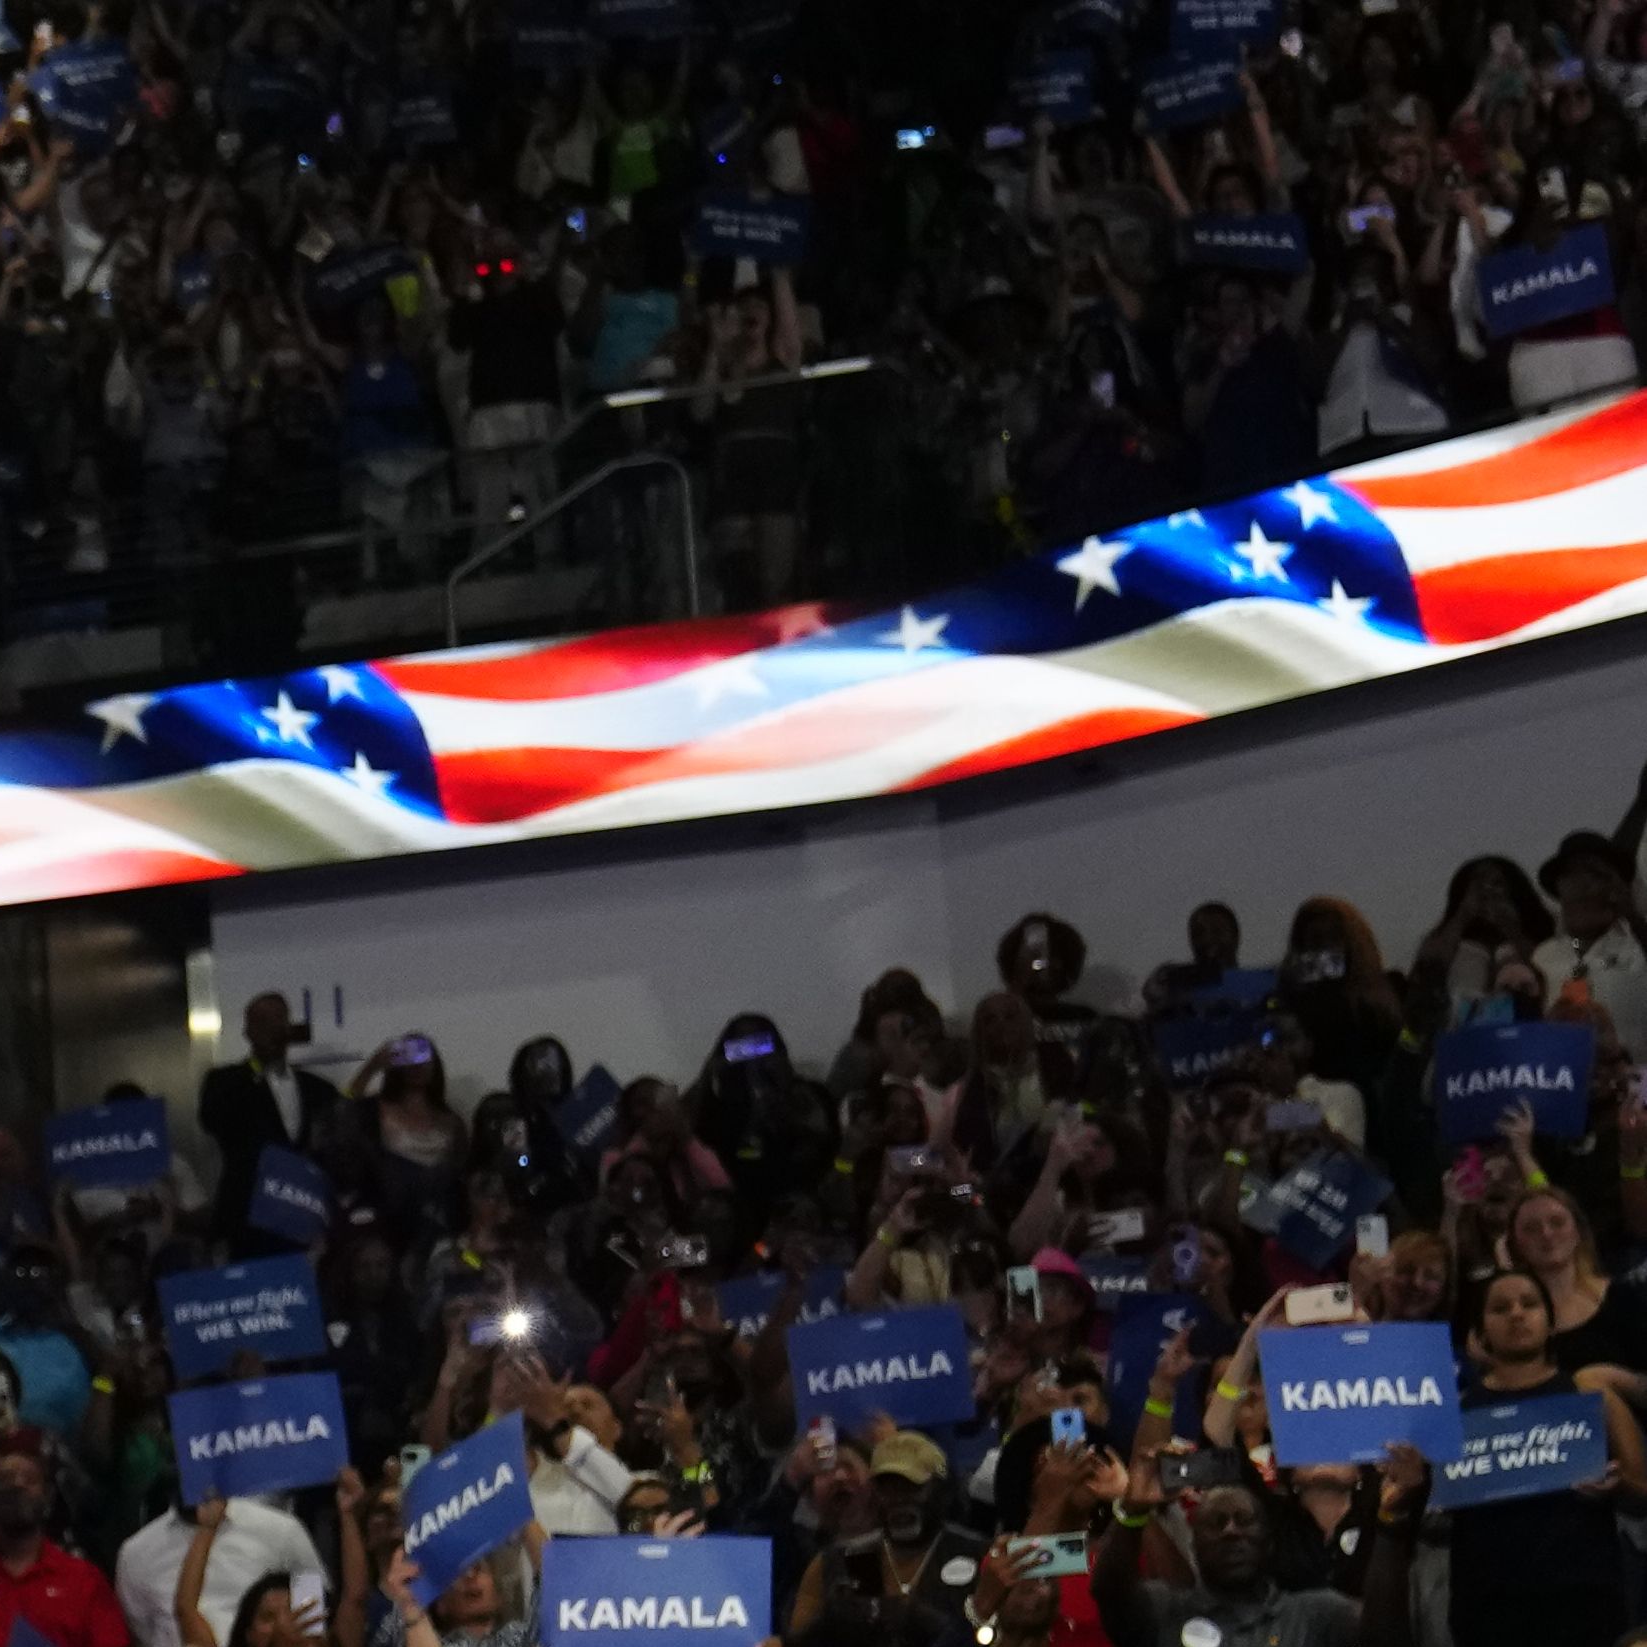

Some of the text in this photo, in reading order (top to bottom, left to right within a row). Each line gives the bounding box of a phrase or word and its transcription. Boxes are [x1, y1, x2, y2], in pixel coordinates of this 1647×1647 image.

[1492, 257, 1599, 305] KAMALA
[304, 983, 344, 1028] 11
[1446, 1063, 1576, 1100] KAMALA
[52, 1129, 159, 1164] KAMALA
[195, 1320, 237, 1345] WE
[806, 1349, 954, 1397] KAMALA
[1281, 1376, 1443, 1412] KAMALA
[188, 1413, 331, 1462] KAMALA
[1443, 1446, 1569, 1482] WE WIN.
[403, 1461, 514, 1554] KAMALA
[558, 1593, 749, 1632] KAMALA
